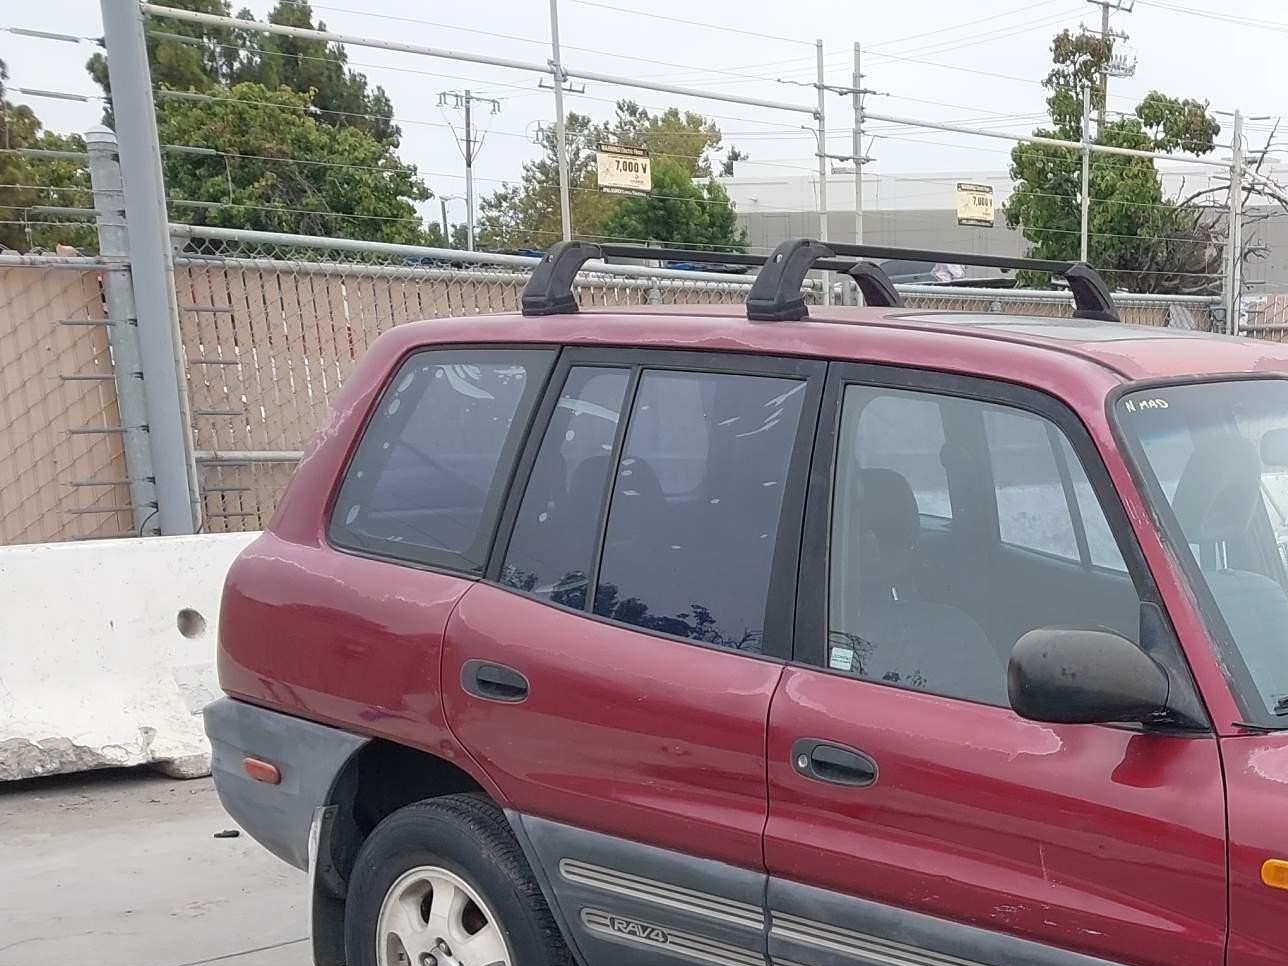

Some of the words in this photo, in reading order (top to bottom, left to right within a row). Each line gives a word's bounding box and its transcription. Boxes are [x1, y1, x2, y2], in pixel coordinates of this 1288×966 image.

[615, 160, 639, 173] 7,000
[641, 163, 647, 174] V
[614, 919, 664, 941] RAV4
